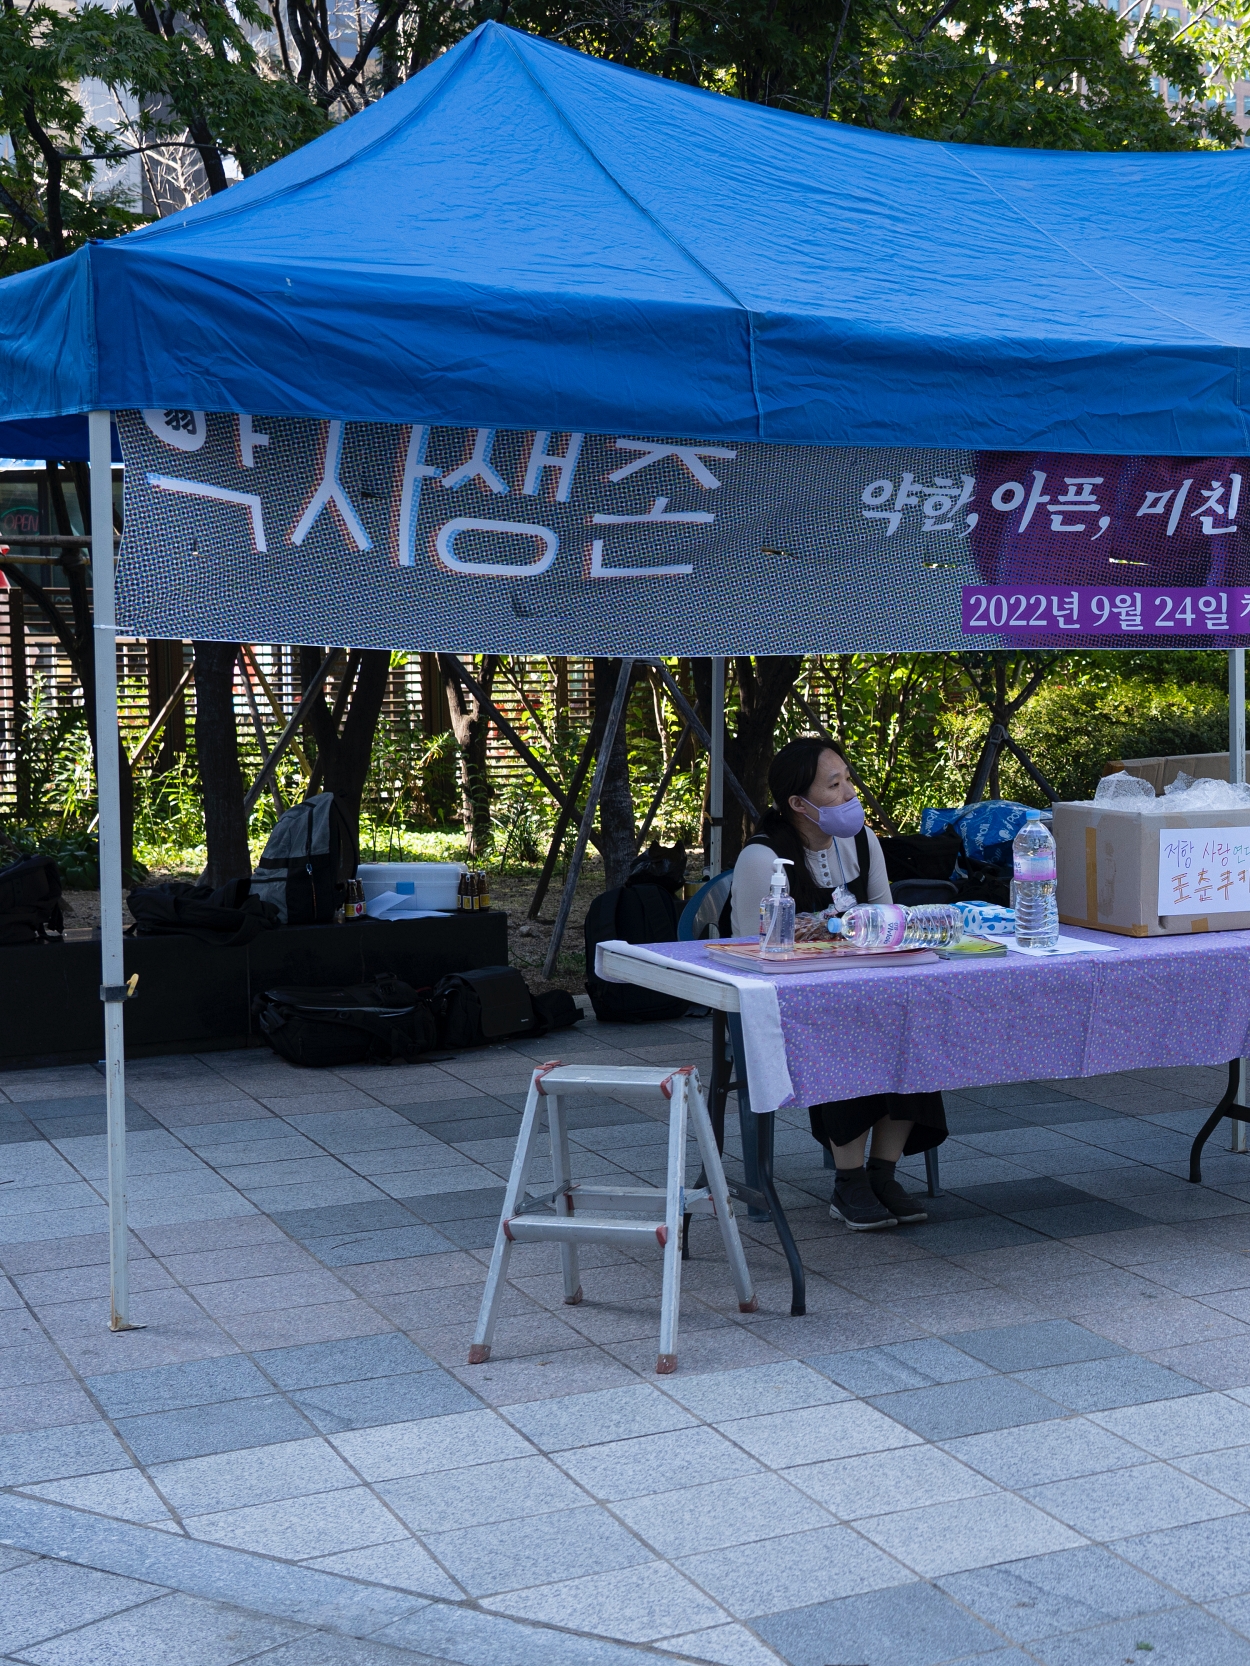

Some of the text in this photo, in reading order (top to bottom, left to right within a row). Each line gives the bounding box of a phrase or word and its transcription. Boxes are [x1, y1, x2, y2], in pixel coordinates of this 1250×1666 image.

[861, 473, 980, 538] 약한,
[991, 470, 1113, 541] 아픈,
[1136, 473, 1241, 537] 미친
[3, 514, 40, 532] OPEN
[969, 593, 1081, 631] 2022년
[1091, 592, 1142, 631] 9월
[1154, 592, 1229, 631] 24일
[1164, 840, 1195, 869] 저항
[1202, 839, 1231, 867] 사랑
